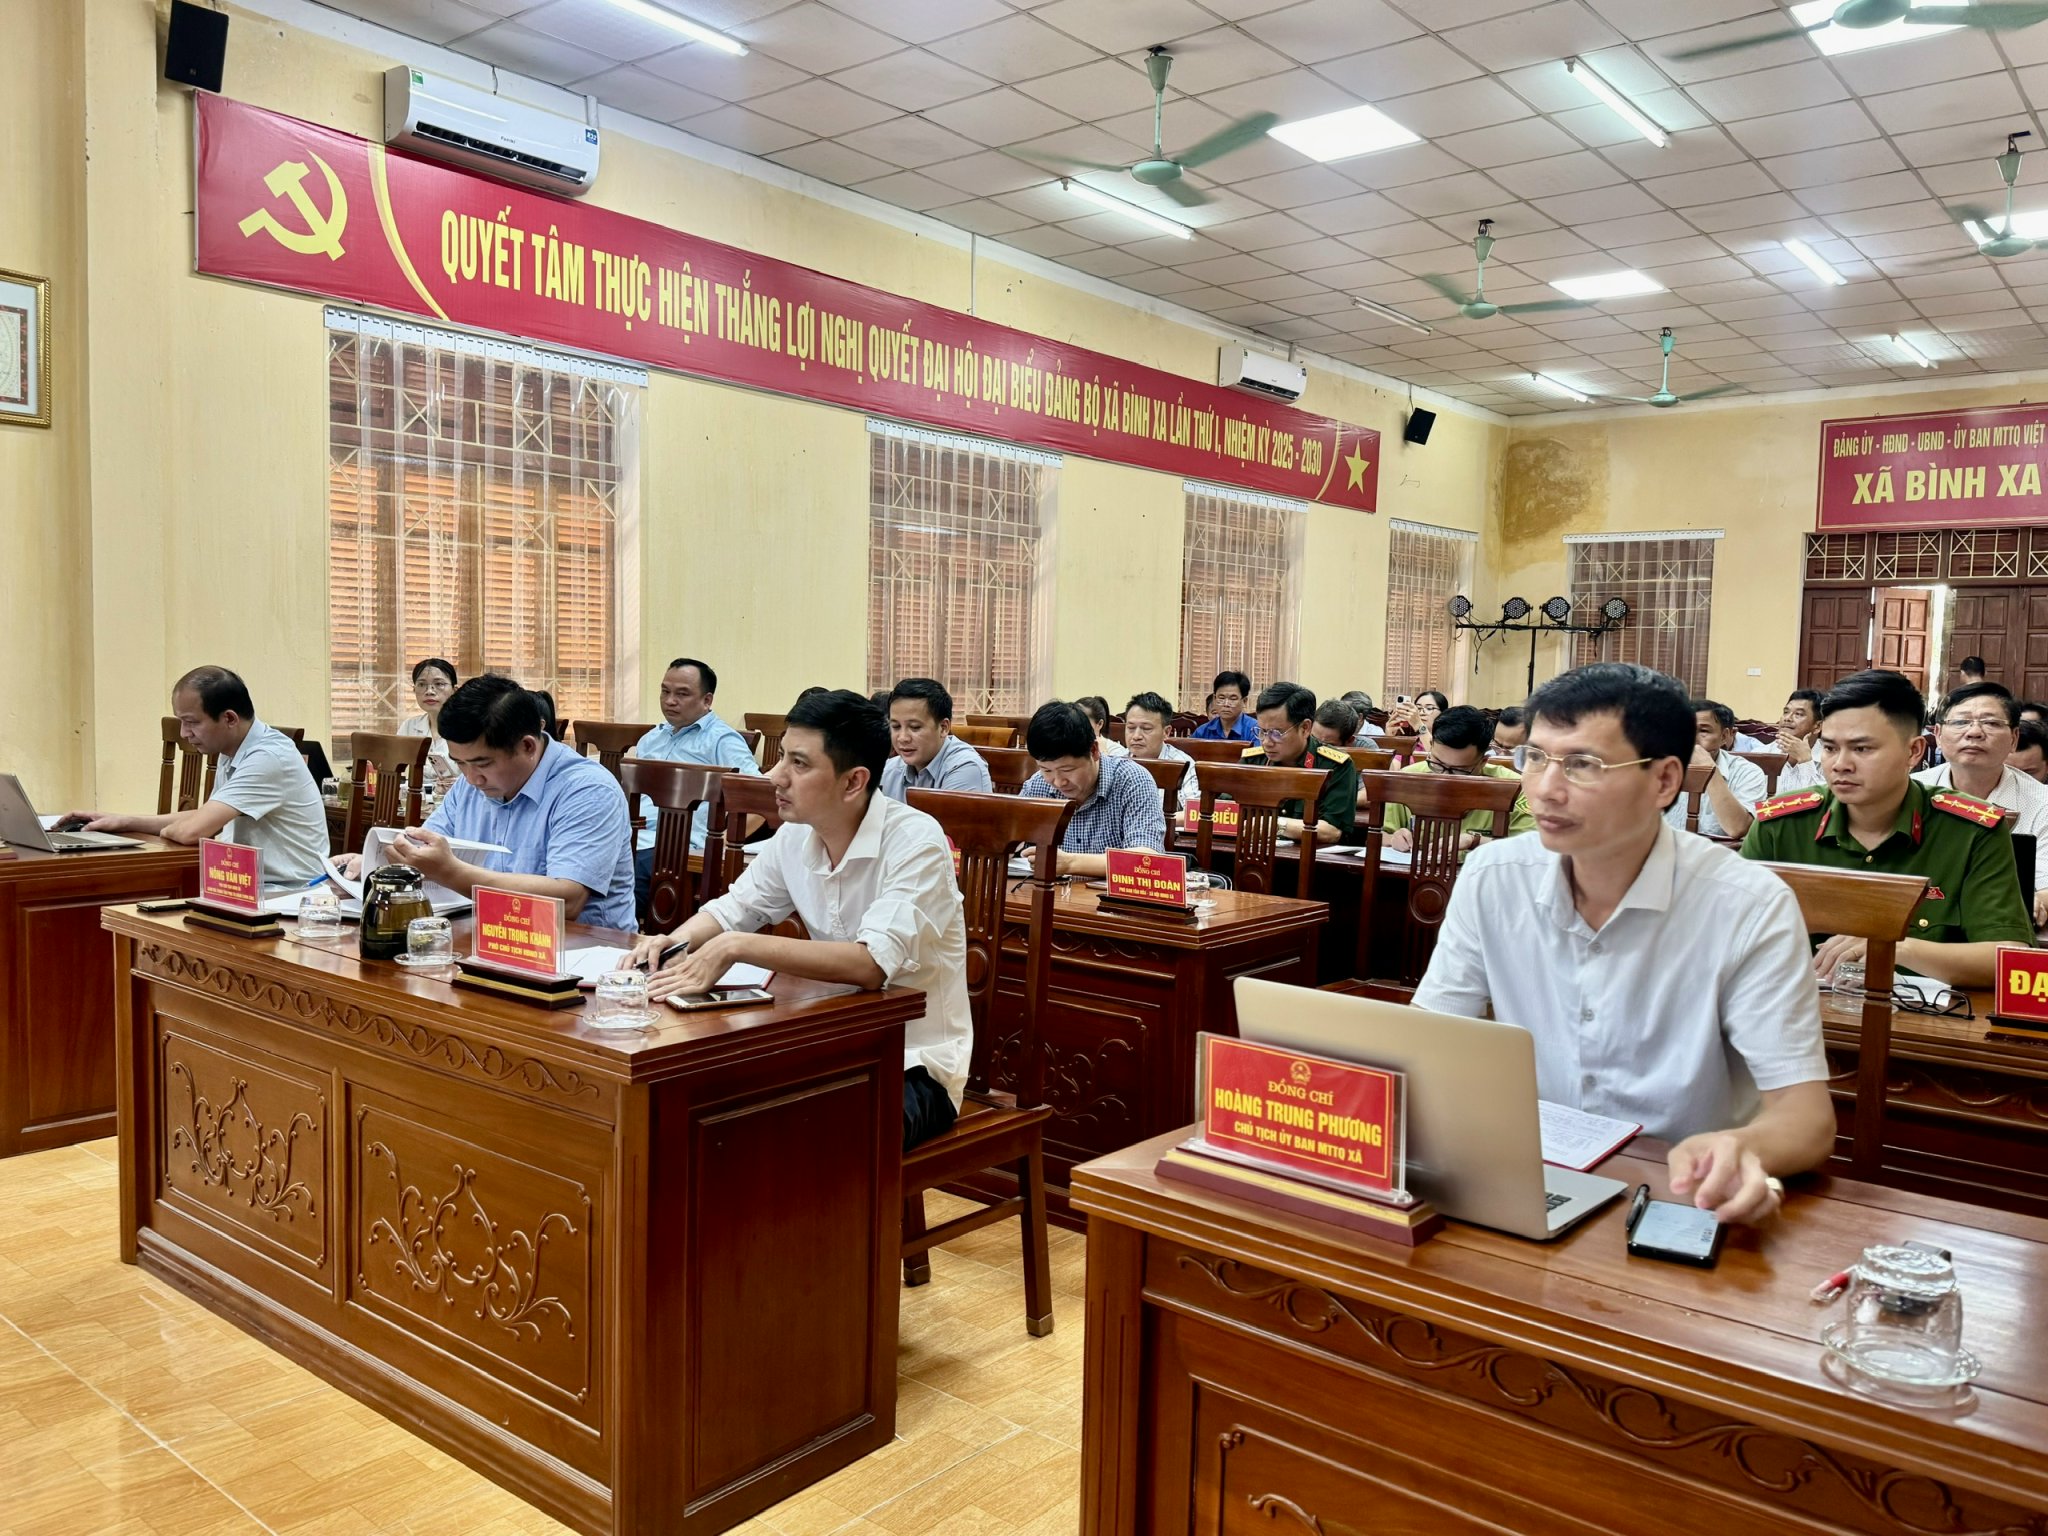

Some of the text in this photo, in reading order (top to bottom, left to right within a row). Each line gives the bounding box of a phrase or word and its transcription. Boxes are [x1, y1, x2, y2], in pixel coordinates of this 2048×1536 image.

[441, 205, 524, 291] QUYẾT
[531, 224, 585, 306] TÂM
[592, 248, 651, 331] THỰC
[658, 261, 709, 344] HIỆN
[715, 269, 781, 352] THẮNG
[787, 301, 815, 371] LỢI
[821, 311, 863, 384] NGHỊ
[868, 319, 919, 385] QUYẾT
[923, 339, 949, 401] ĐẠI
[954, 340, 979, 408] HỘI
[982, 354, 1007, 415] ĐẠI
[1010, 348, 1041, 414] BIỂU
[1044, 358, 1080, 423] ĐẢNG
[1083, 375, 1100, 437] BỘ
[1103, 380, 1119, 431] XÃ
[1122, 384, 1150, 438] BÌNH
[1152, 398, 1167, 442] XA
[1170, 391, 1191, 447] LẦN
[1193, 404, 1214, 452] THỨ
[1215, 415, 1221, 459] I,
[1224, 413, 1256, 468] NHIỆM
[1257, 419, 1270, 464] KỲ
[1271, 430, 1294, 470] 2025
[1300, 437, 1322, 476] 2030
[1833, 431, 1859, 458] ĐẢNG
[1861, 429, 1874, 456] ỦY
[1882, 433, 1909, 454] HĐND
[1917, 430, 1945, 452] UBND
[1953, 423, 1967, 449] ỦY
[1969, 427, 1991, 448] BAN
[1993, 424, 2020, 448] MTTQ
[2023, 419, 2046, 449] VIỆT
[1852, 462, 2042, 505] XÃ BÌNH XA
[1212, 807, 1238, 824] BIỂU
[239, 872, 252, 888] VIỆT
[1111, 873, 1181, 892] ĐINH THỊ ĐOÀN
[482, 921, 552, 948] NGUYỄN TRỌNG KHÁNH
[1267, 1077, 1334, 1106] ĐỒNG CHÍ
[1215, 1087, 1383, 1147] HOÀNG TRUNG PHƯƠNG
[1234, 1119, 1254, 1136] CHỦ
[1255, 1124, 1277, 1143] TỊCH
[1279, 1128, 1292, 1146] ỦY
[1294, 1136, 1316, 1152] BAN
[1317, 1142, 1346, 1160] MTTQ
